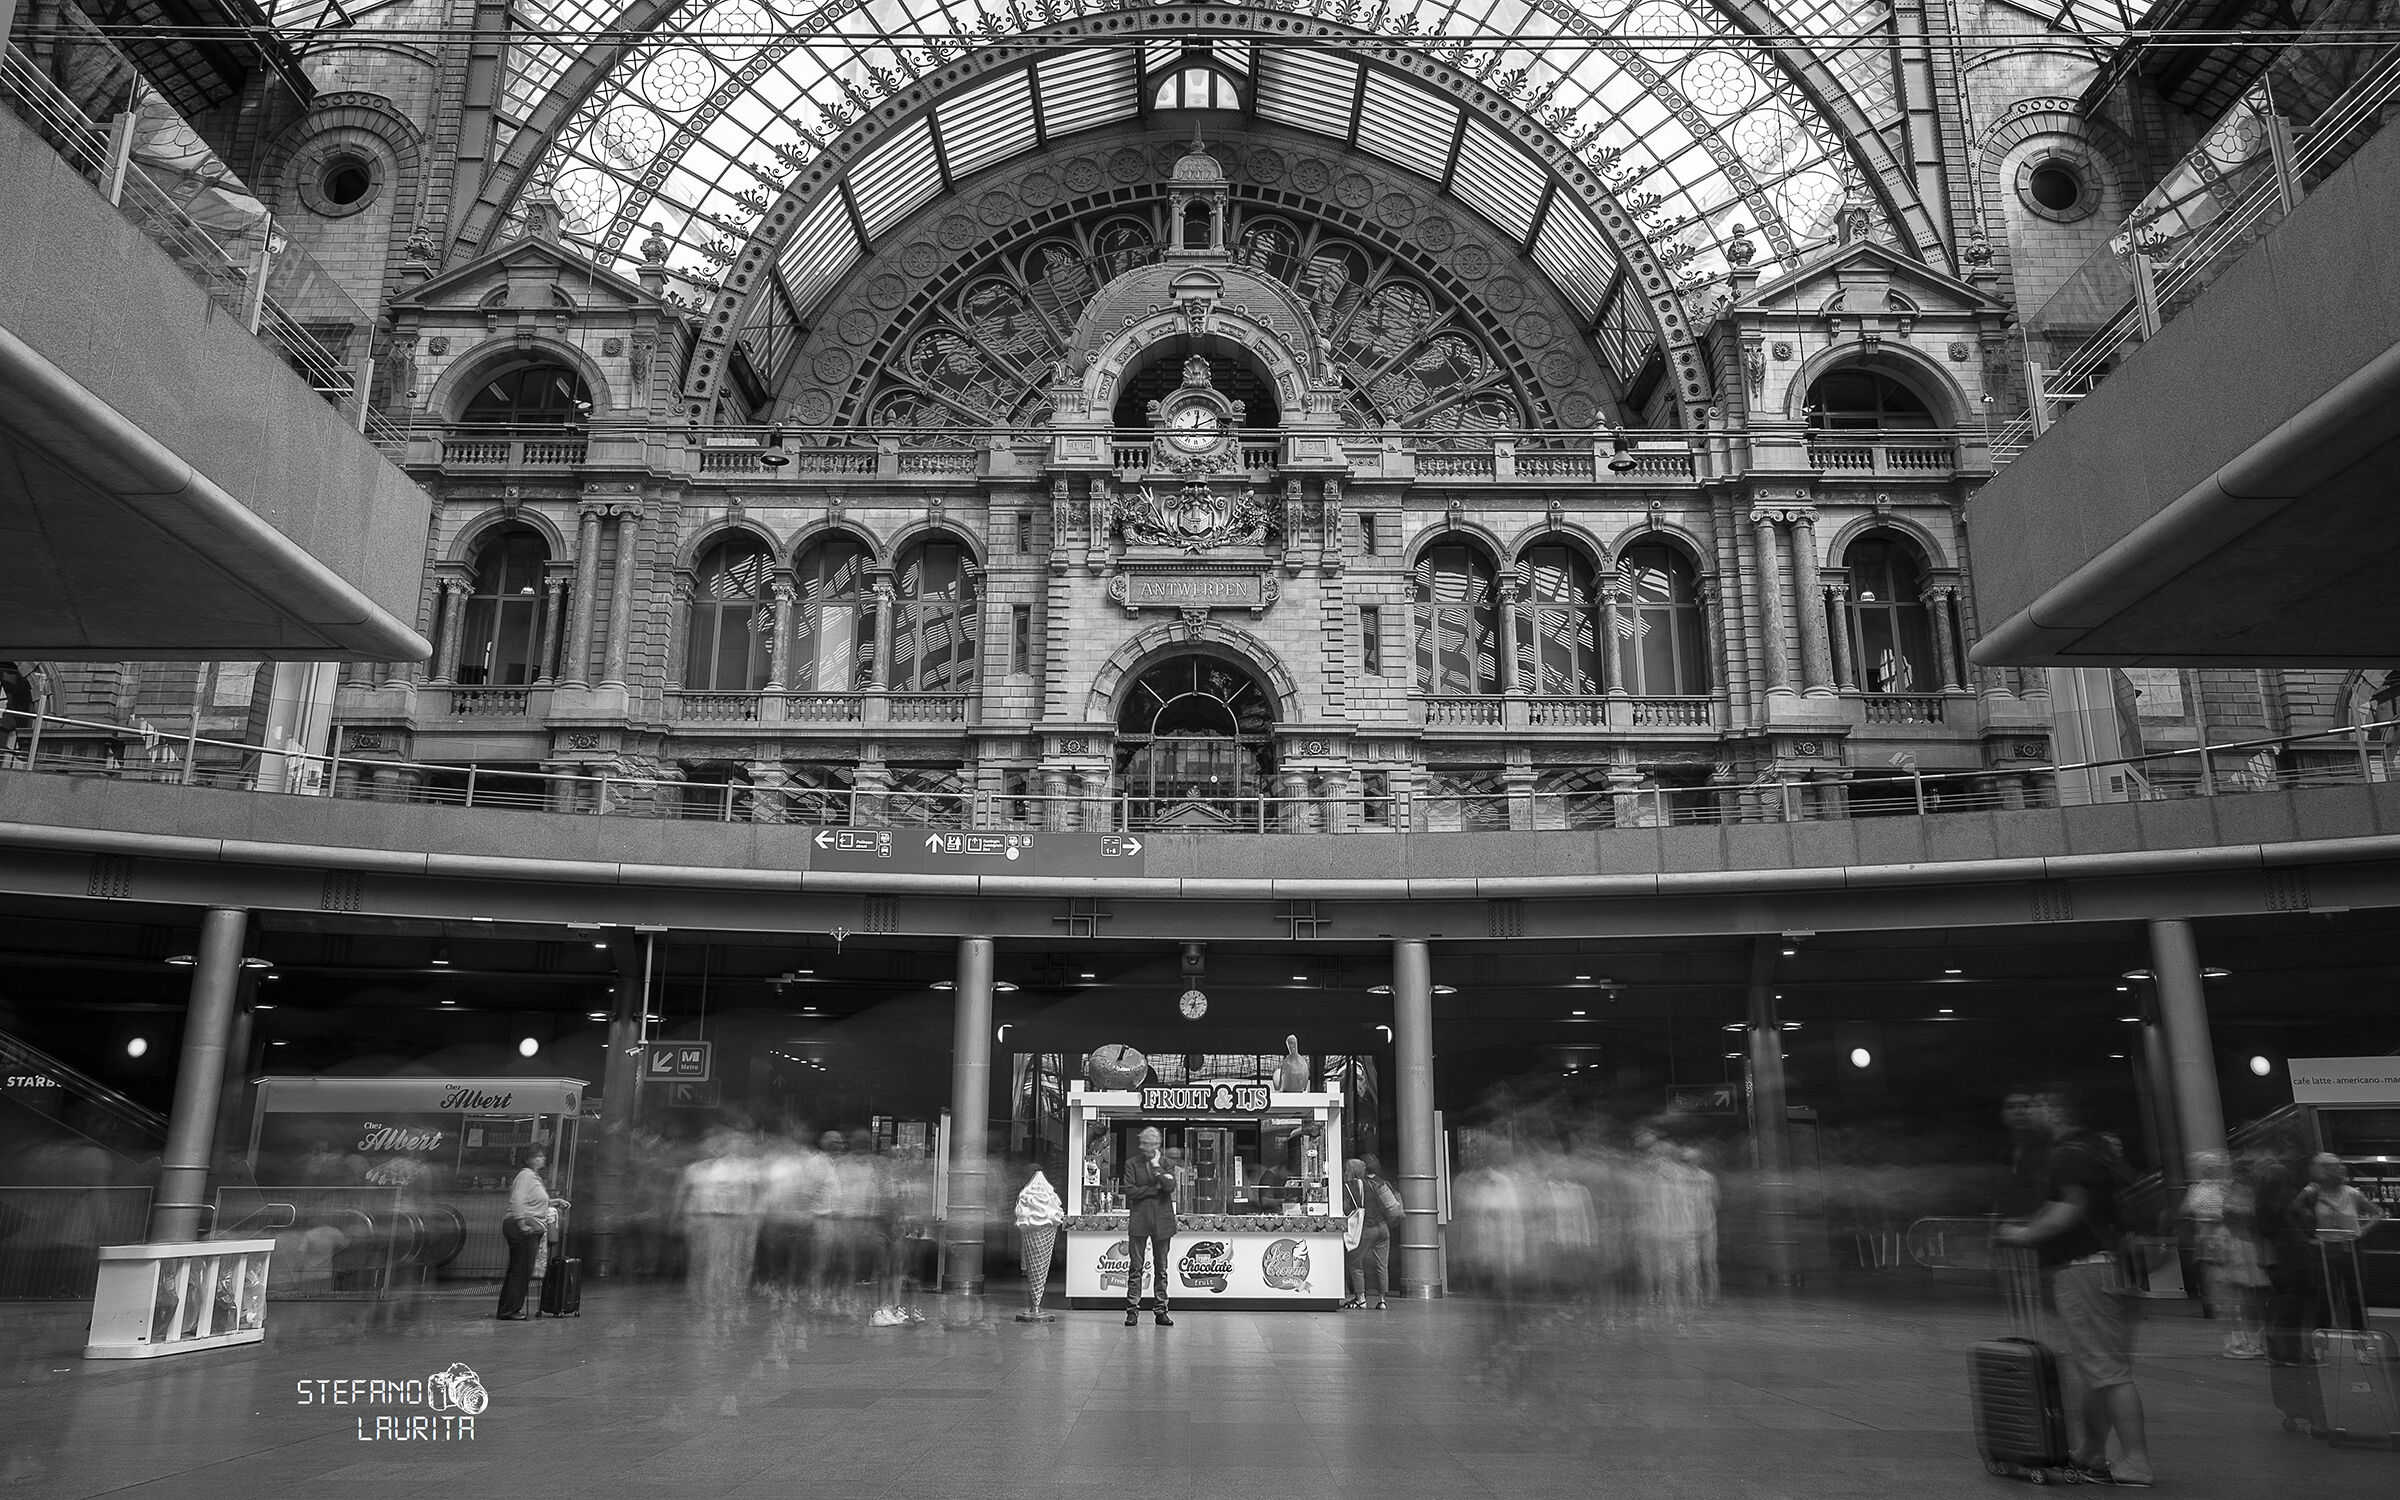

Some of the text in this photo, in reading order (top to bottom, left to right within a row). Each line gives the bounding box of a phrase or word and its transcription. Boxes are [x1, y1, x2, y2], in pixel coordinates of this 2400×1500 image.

[1140, 581, 1248, 597] ANTWERPEN
[7, 1075, 62, 1087] STARB
[2293, 1077, 2310, 1085] cafe
[2336, 1076, 2380, 1084] americano
[440, 1089, 512, 1109] Albert
[1143, 1087, 1268, 1110] FRUIT & IJS
[363, 1121, 383, 1130] Chez
[357, 1127, 443, 1151] Albert
[1096, 1254, 1151, 1270] Smooe
[1178, 1257, 1233, 1273] Chocolate
